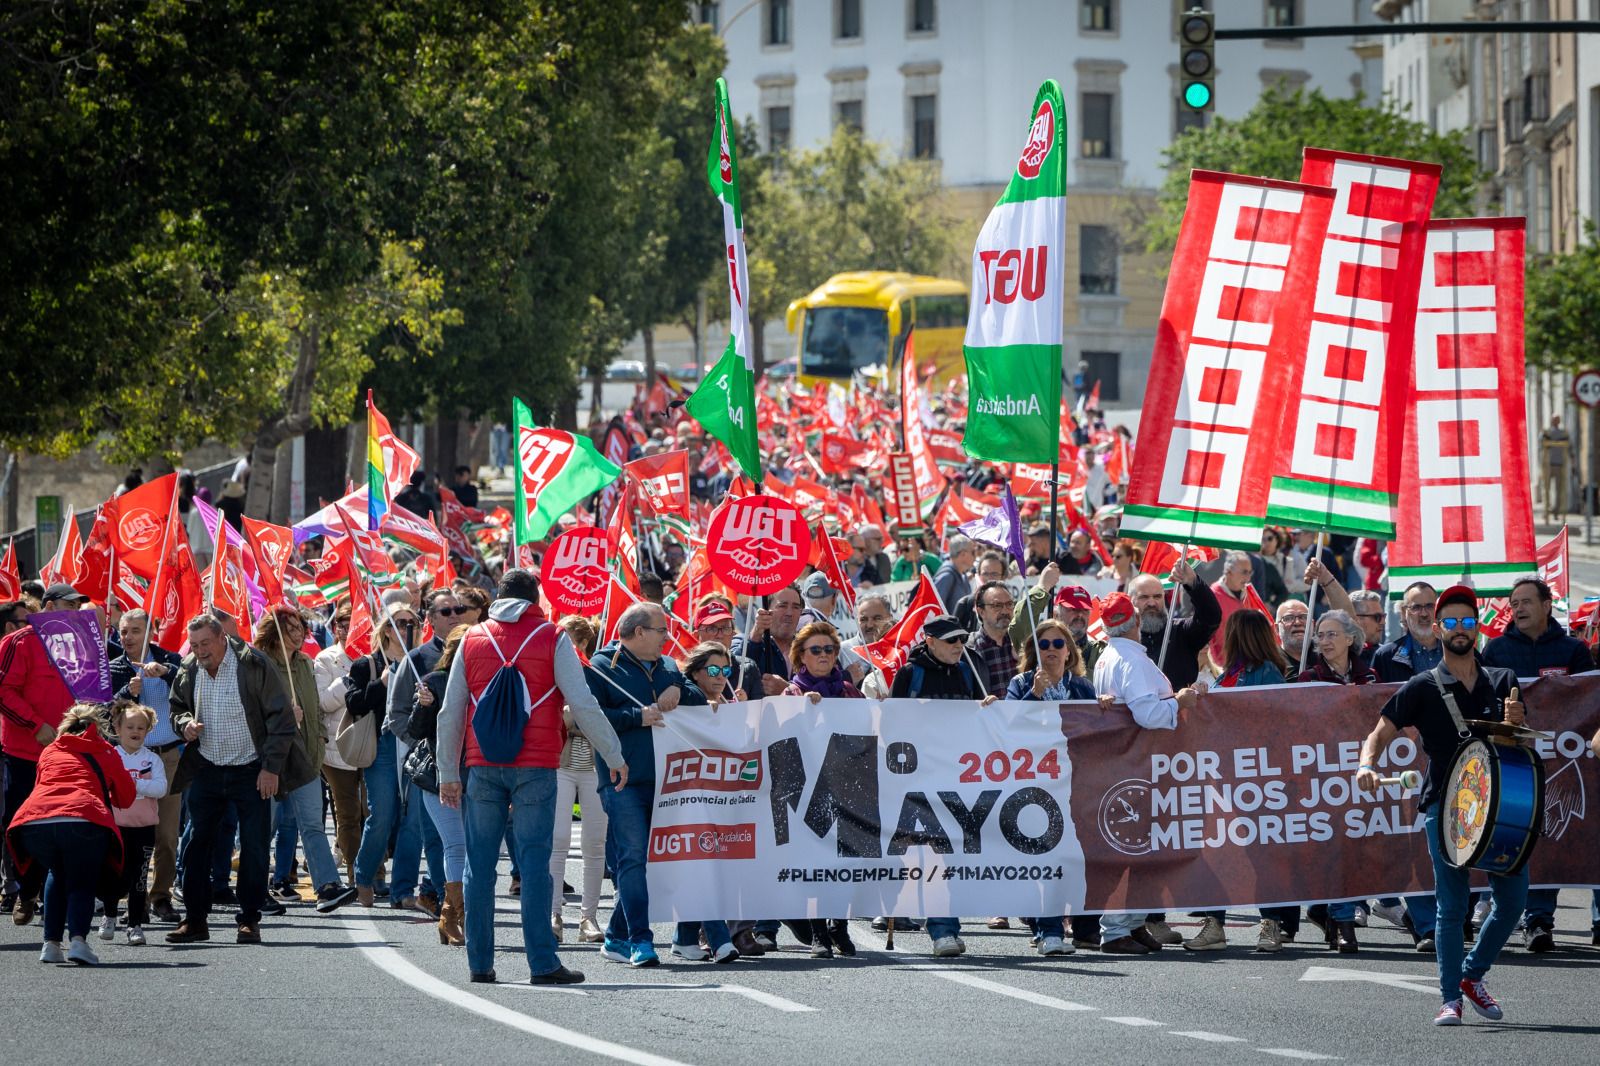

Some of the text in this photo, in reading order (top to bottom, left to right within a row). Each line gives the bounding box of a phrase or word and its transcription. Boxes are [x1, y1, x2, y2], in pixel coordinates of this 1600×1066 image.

[1158, 182, 1304, 512] CCOO
[1416, 228, 1506, 565] CCOO
[1580, 382, 1600, 397] 40
[893, 457, 918, 524] CCOO
[124, 512, 153, 538] UGT
[722, 504, 797, 545] UGT
[554, 536, 608, 568] UGT
[727, 568, 782, 585] Andalucía
[557, 593, 603, 608] Andalucía
[89, 620, 110, 691] www.ugt.es
[1535, 730, 1593, 760] EO:
[666, 757, 745, 784] CCOO
[958, 748, 1061, 783] 2024
[1151, 751, 1223, 784] POR
[1233, 747, 1282, 778] EL
[729, 796, 737, 805] de
[1151, 770, 1425, 817] MENOS JORNA
[653, 832, 696, 855] UGT
[1151, 805, 1428, 850] MEJORES SALA
[777, 867, 923, 883] #PLENOEMPLEO
[941, 865, 1063, 881] #1MAYO2024
